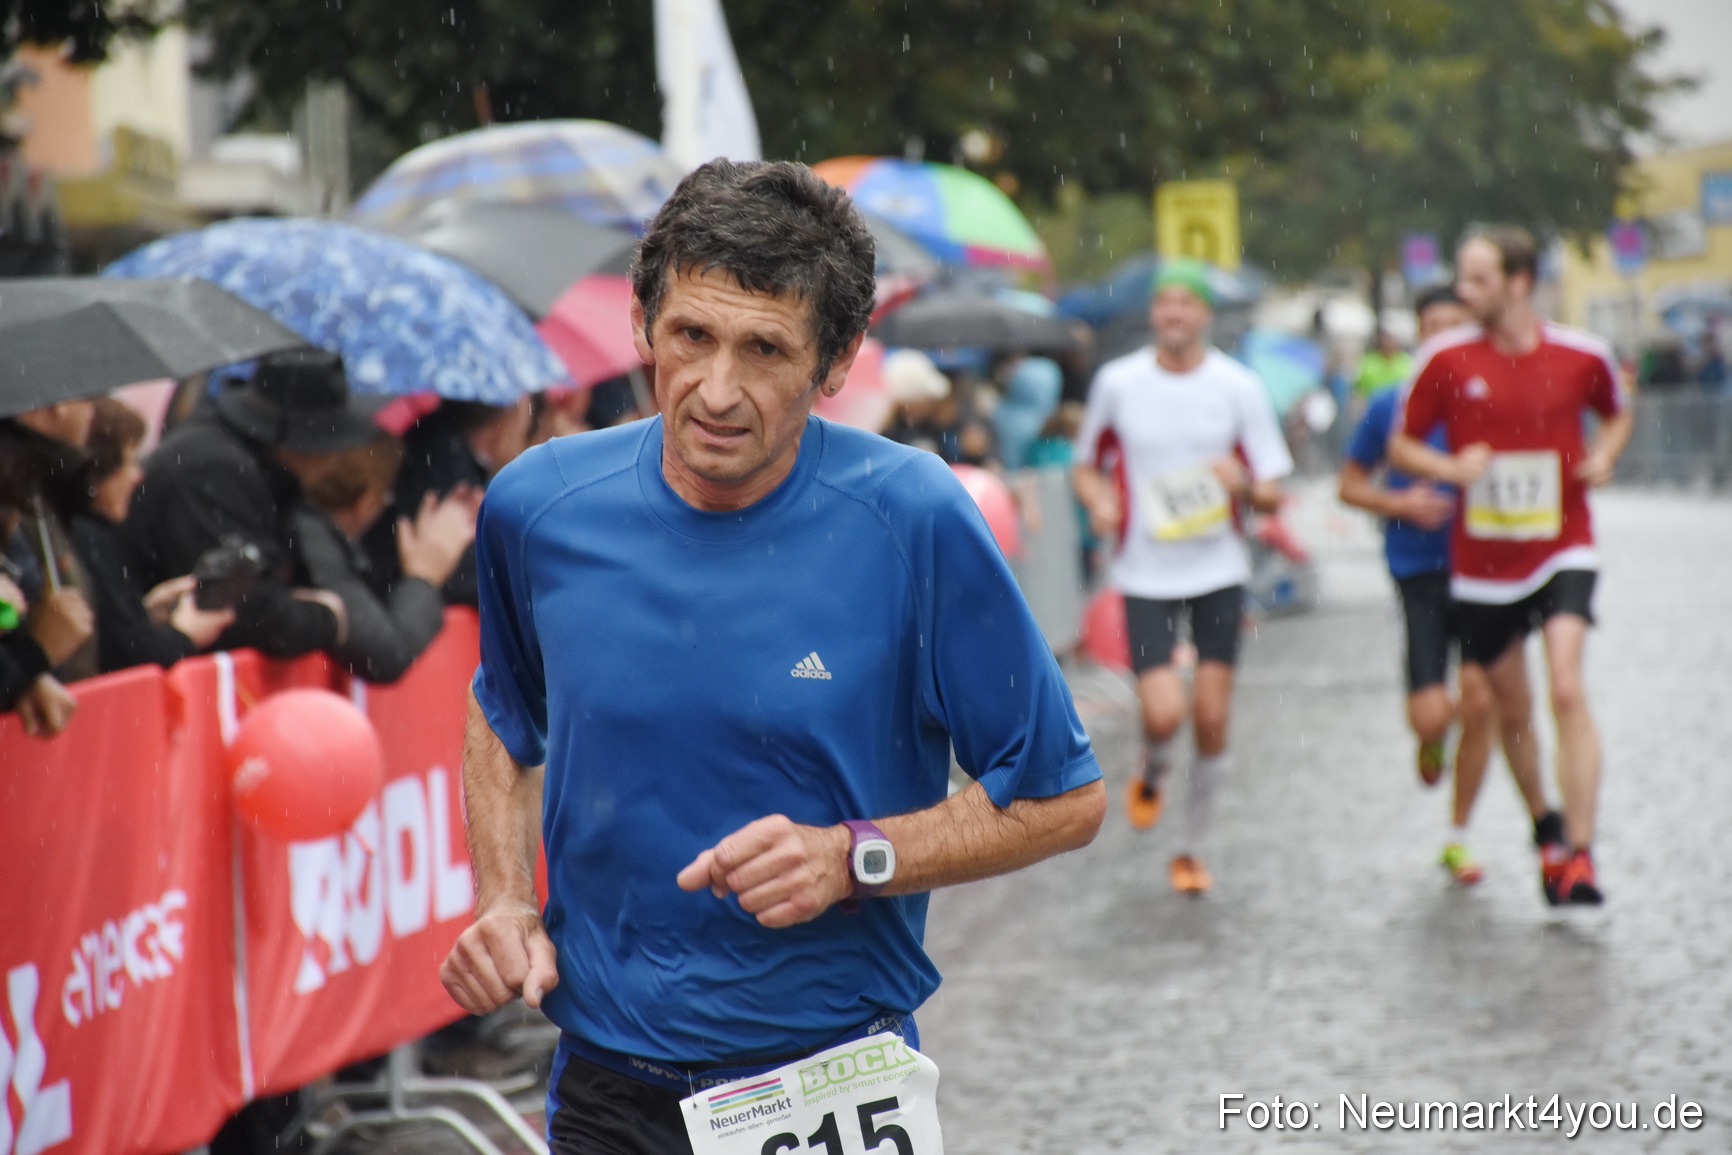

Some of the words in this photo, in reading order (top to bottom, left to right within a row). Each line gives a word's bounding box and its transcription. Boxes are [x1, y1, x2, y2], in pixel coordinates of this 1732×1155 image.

[790, 668, 832, 680] adidas
[798, 1038, 917, 1096] BOCK
[804, 1088, 838, 1107] inspired
[840, 1084, 851, 1094] by
[853, 1077, 881, 1090] smart
[883, 1065, 921, 1081] concepts
[709, 1097, 793, 1131] NeuerMarkt
